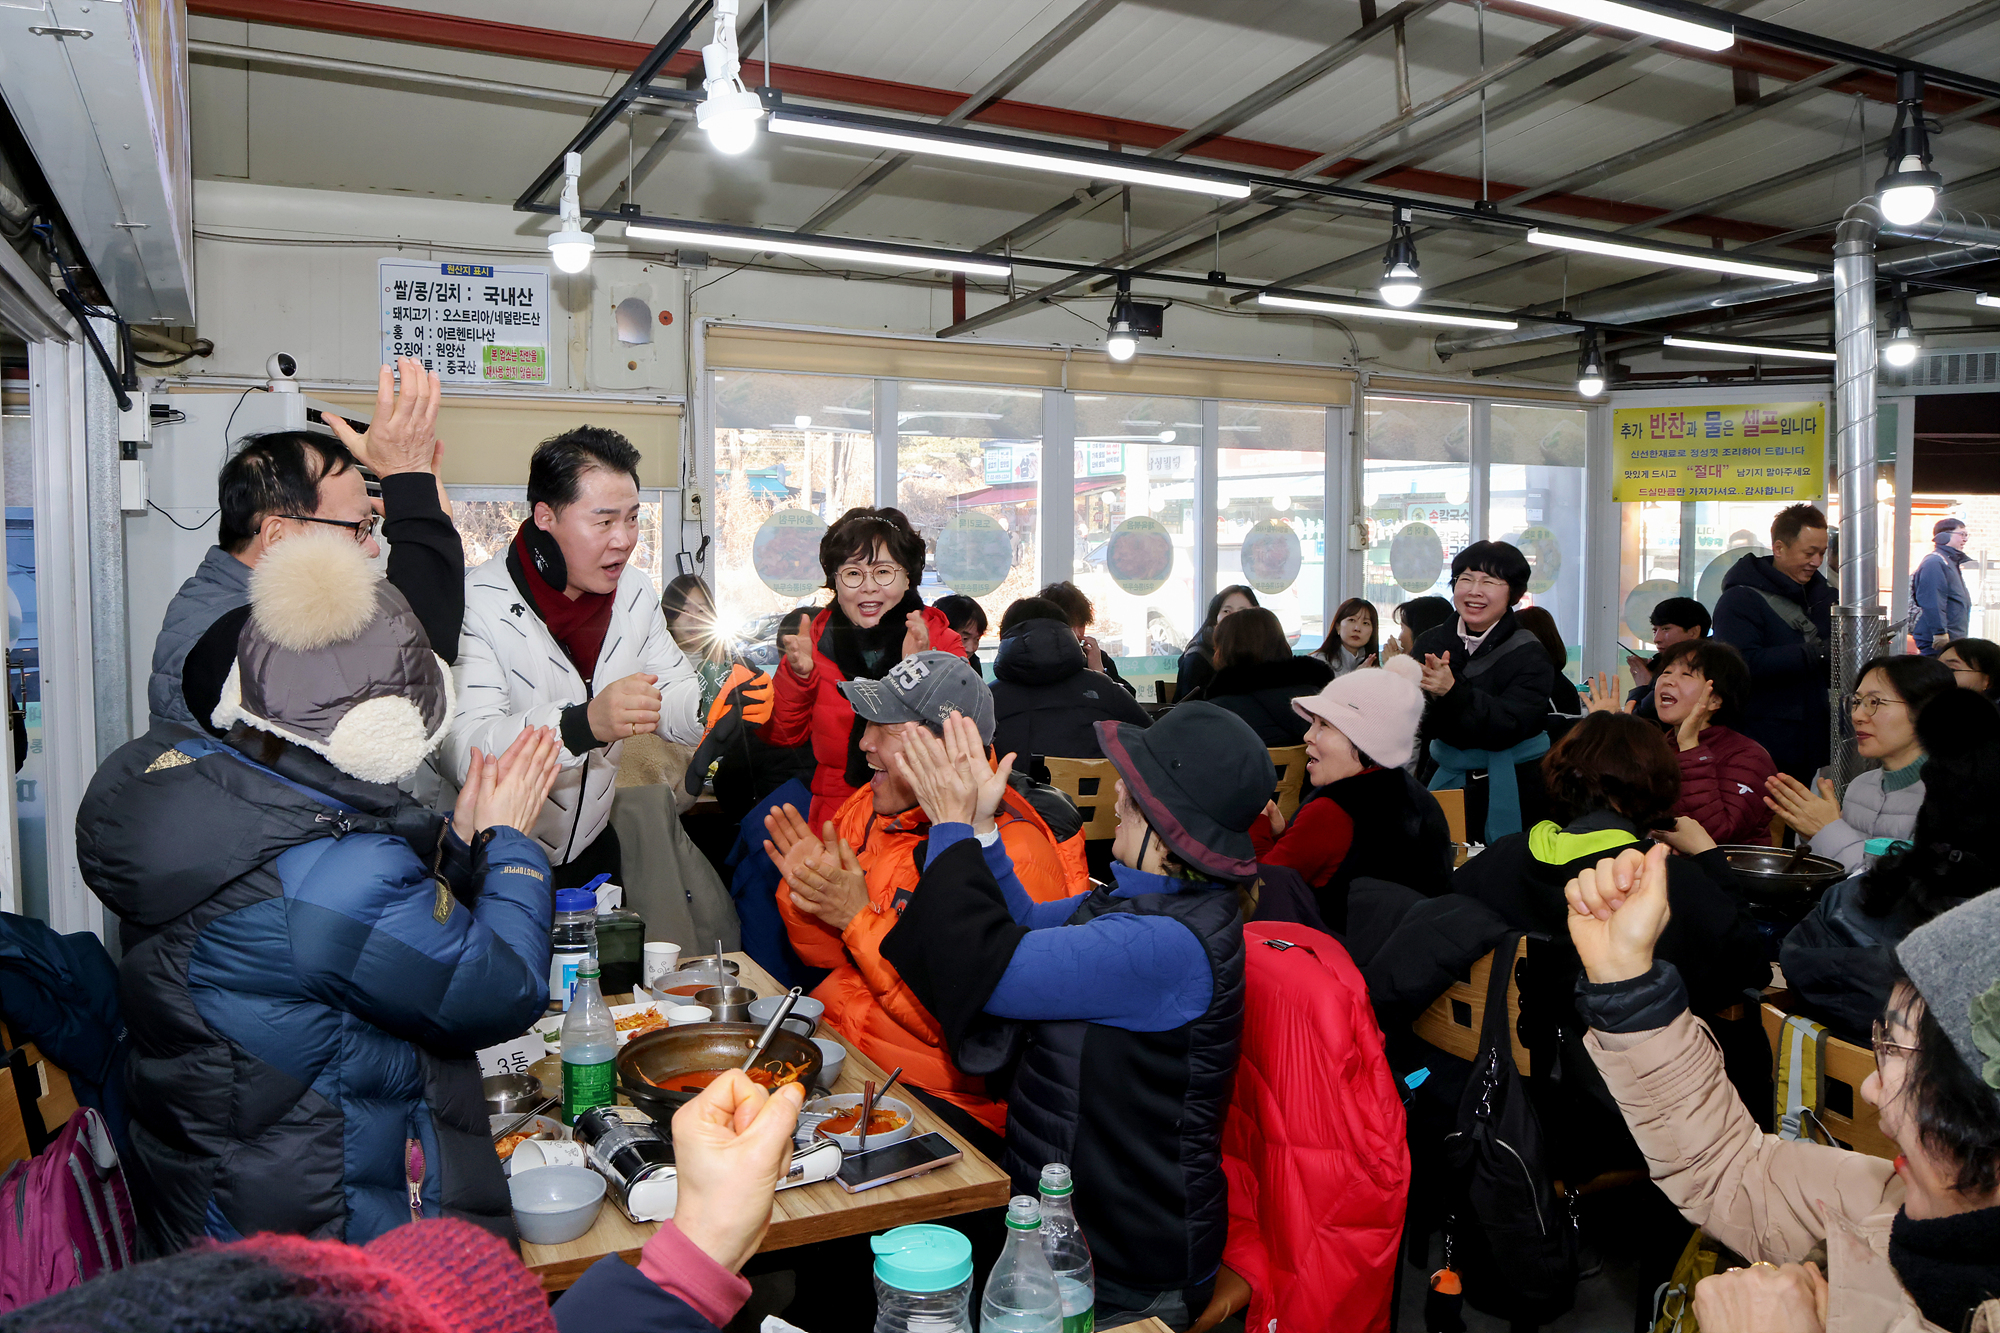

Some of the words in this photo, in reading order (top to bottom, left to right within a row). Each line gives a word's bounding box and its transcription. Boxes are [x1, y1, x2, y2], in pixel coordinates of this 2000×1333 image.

[446, 264, 470, 275] 원산지
[473, 266, 489, 276] 표시
[393, 280, 461, 303] 쌀/콩/김치
[483, 286, 534, 307] 국내산
[392, 306, 431, 322] 돼지고기
[442, 309, 541, 326] 오스트리아/네덜란드산
[437, 327, 496, 342] 아르헨티나산
[393, 342, 423, 357] 오징어
[435, 342, 465, 358] 원양산
[491, 349, 498, 362] 본
[499, 349, 517, 362] 업소는
[519, 350, 537, 363] 잔반을
[446, 360, 476, 375] 중국산
[485, 365, 503, 379] 재사용
[505, 366, 518, 379] 하지
[519, 366, 544, 379] 않습니다
[1620, 422, 1643, 439] 추가
[1650, 412, 1698, 440] 반찬과
[1703, 411, 1735, 438] 물은
[1741, 409, 1817, 438] 셀프입니다
[1630, 449, 1687, 459] 신선한재료로
[1722, 447, 1761, 457] 조리하여
[1764, 446, 1805, 456] 드립니다
[1624, 470, 1649, 479] 맛있게
[1651, 470, 1677, 479] 드시고
[1736, 468, 1763, 478] 남기지
[1766, 467, 1811, 477] 말아주세요
[1638, 487, 1685, 497] 드실만큼만
